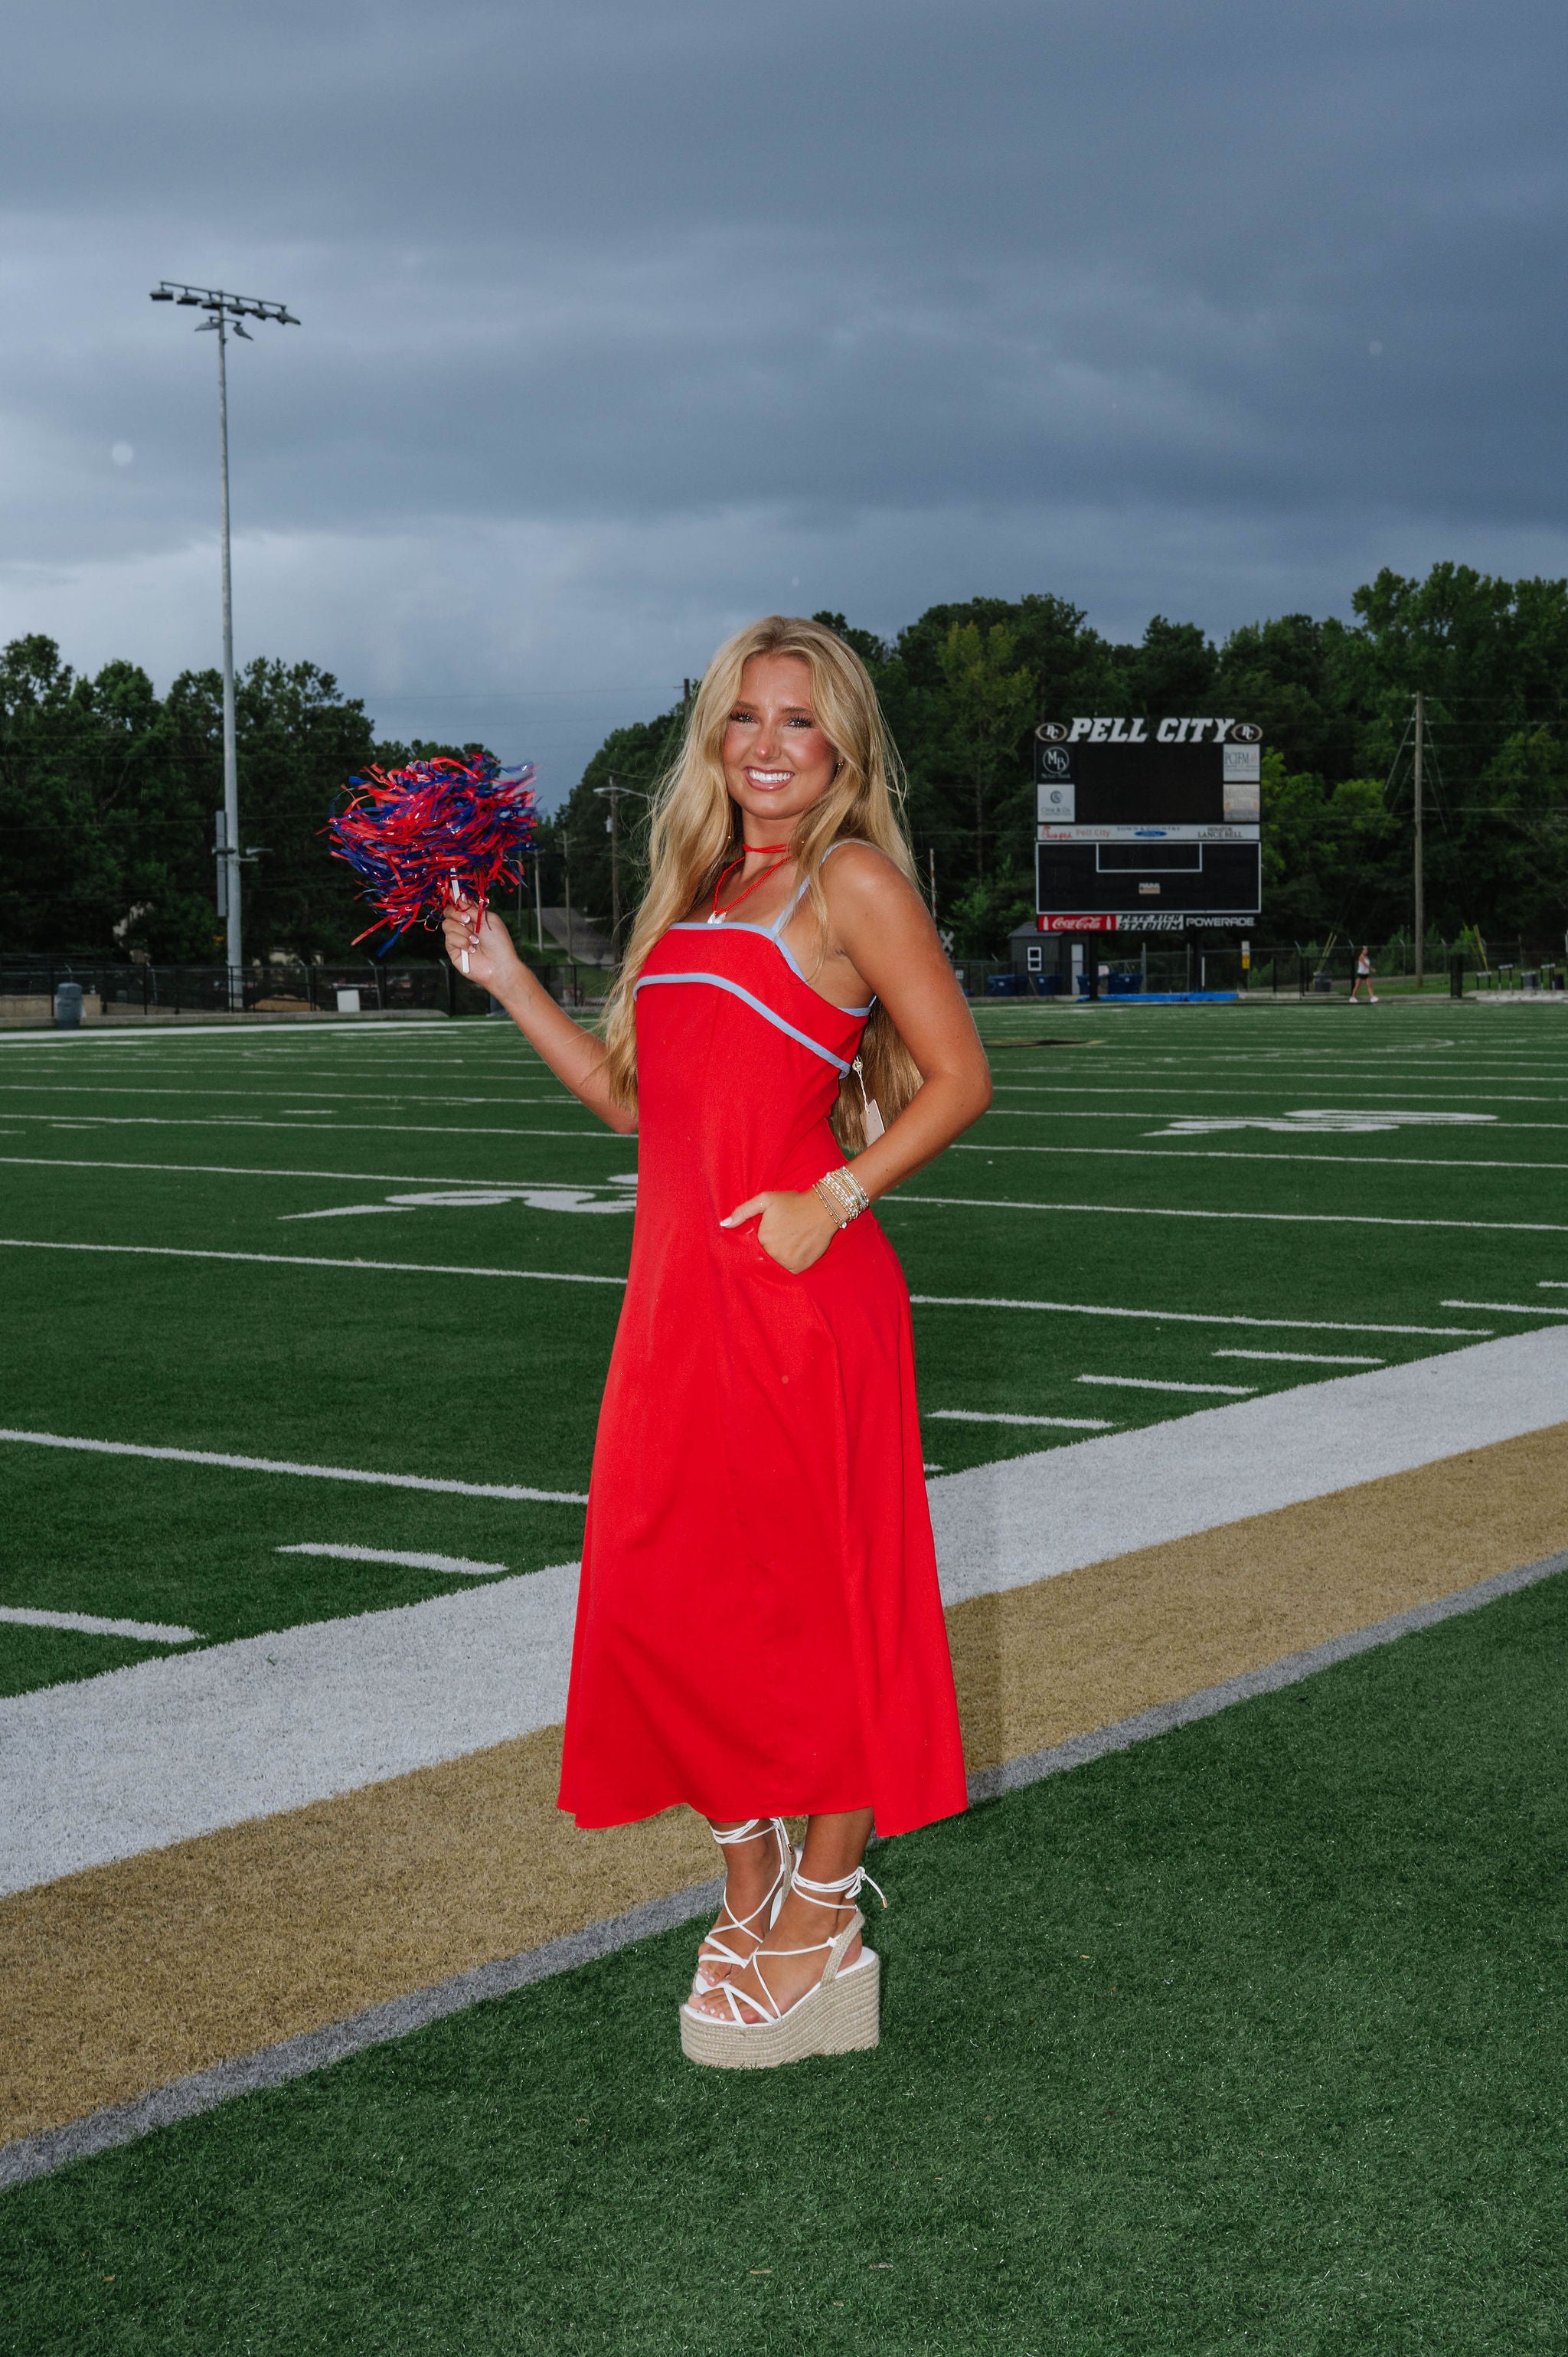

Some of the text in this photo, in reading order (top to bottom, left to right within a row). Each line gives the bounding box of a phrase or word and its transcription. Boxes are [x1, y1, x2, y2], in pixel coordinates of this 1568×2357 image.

[1067, 718, 1236, 743] PELL CITY
[1186, 917, 1255, 927] POWERADE
